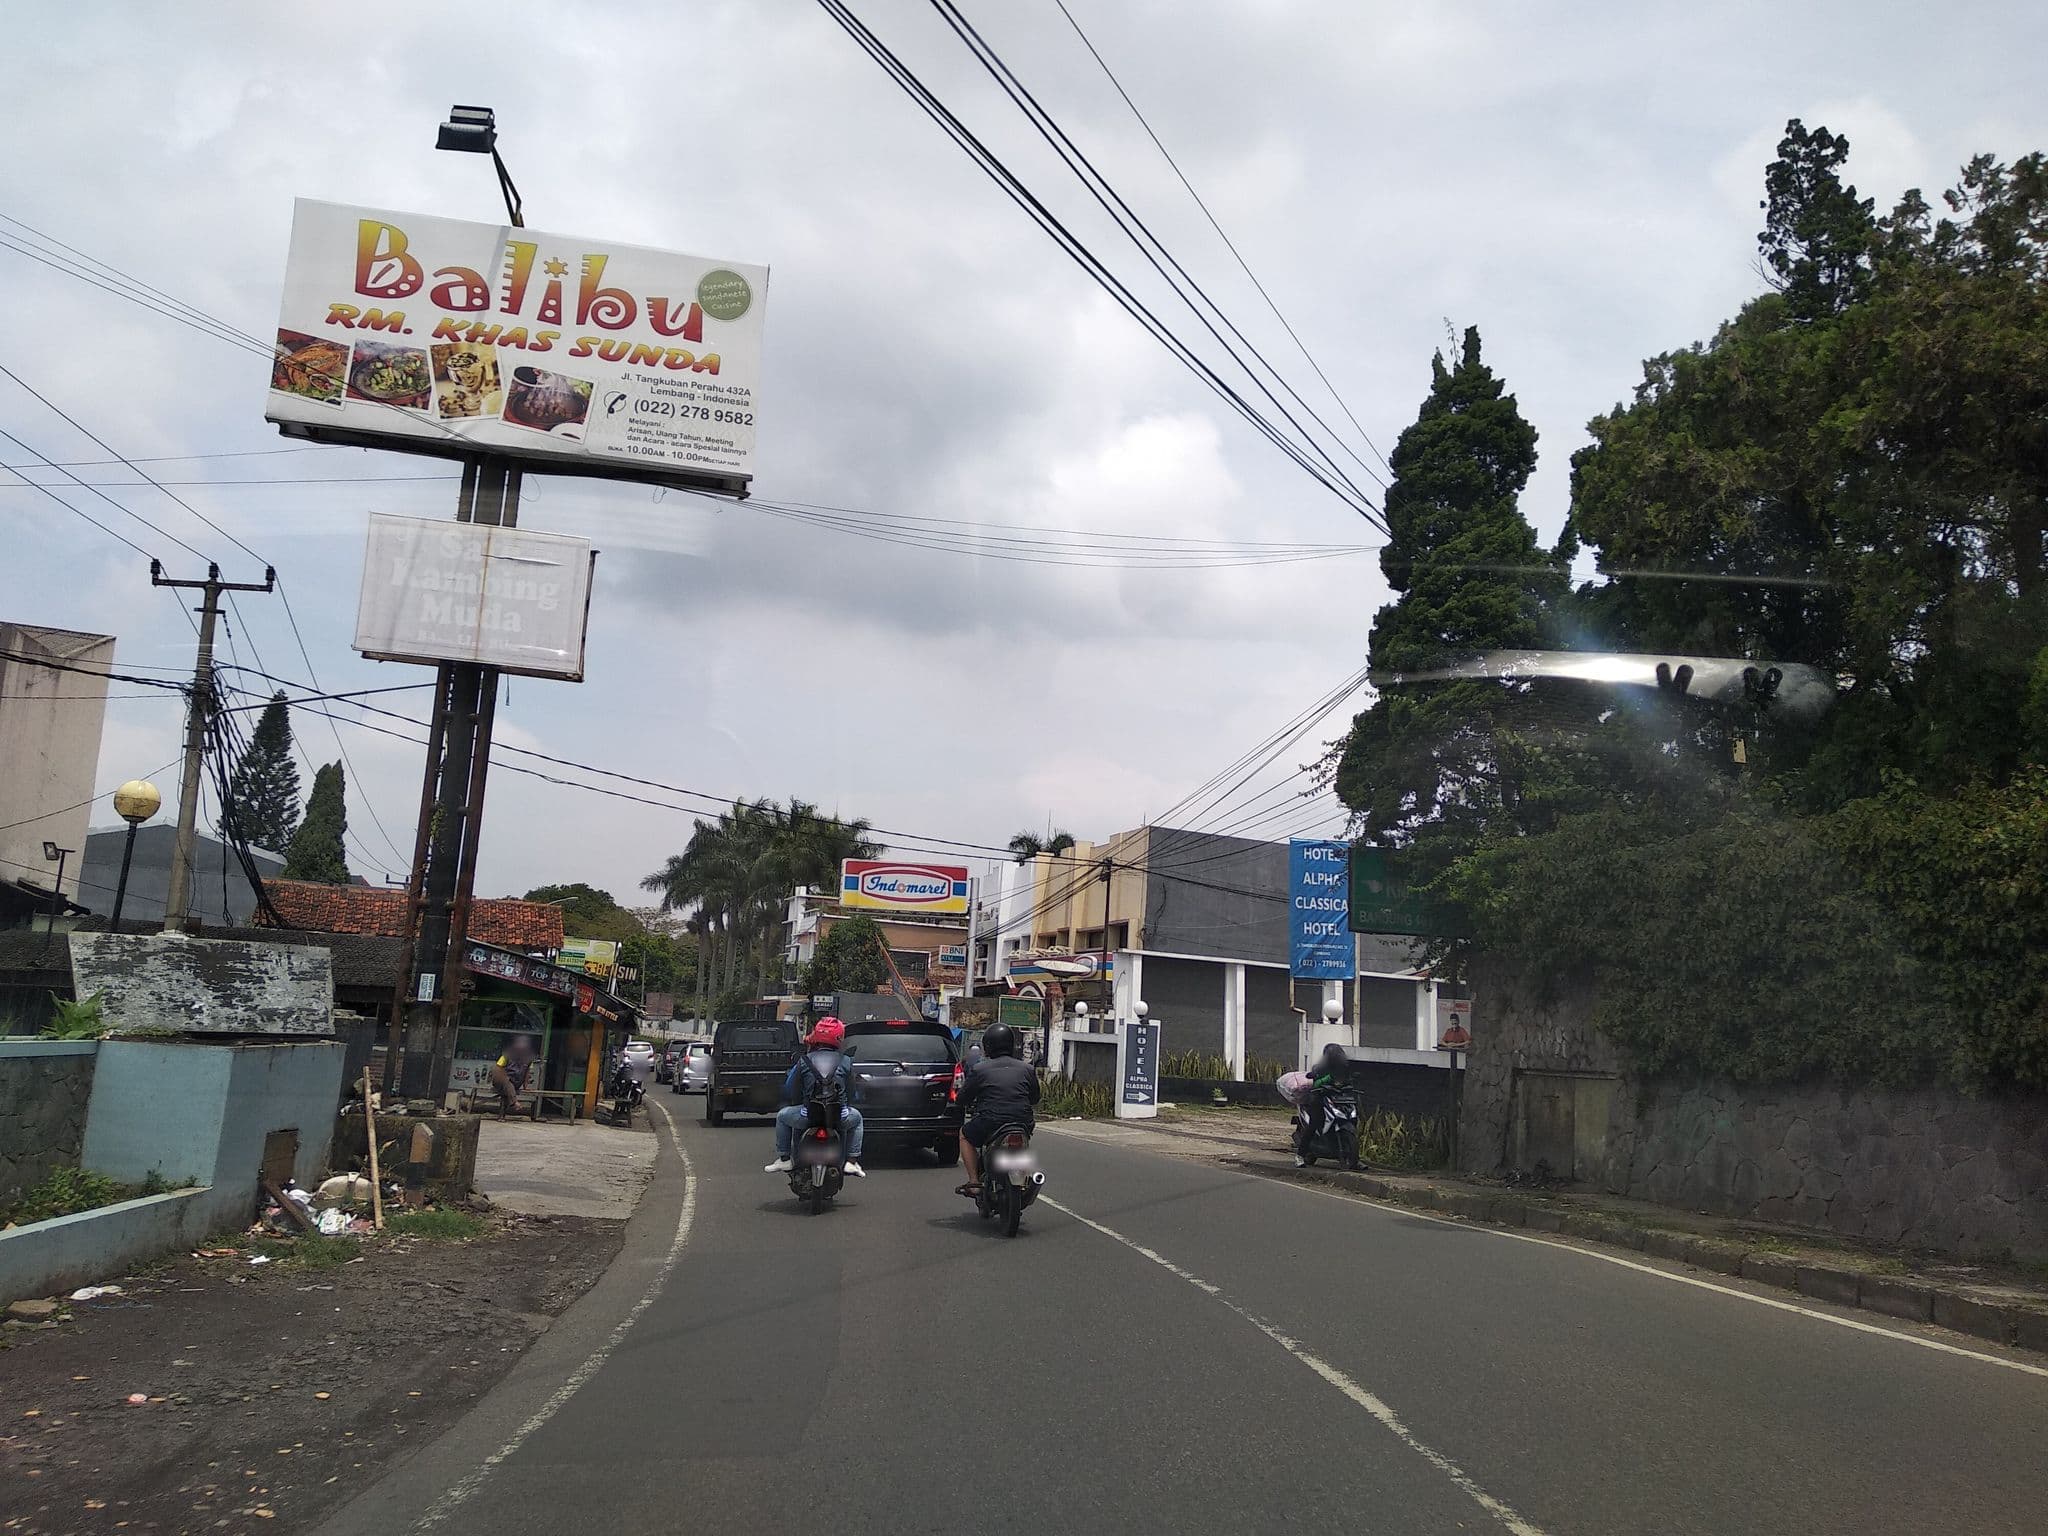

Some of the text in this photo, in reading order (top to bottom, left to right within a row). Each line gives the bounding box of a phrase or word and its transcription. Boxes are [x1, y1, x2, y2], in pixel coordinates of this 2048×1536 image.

[355, 219, 703, 343] Balibu
[325, 303, 721, 376] RM. KHAS SUNDA
[620, 372, 751, 396] Jl. Tangkuban Perahu 432A
[650, 386, 695, 401] Lembang
[703, 393, 750, 407] Indonesia
[634, 399, 754, 426] (022) 278 9582
[627, 434, 641, 442] dan
[642, 436, 665, 445] Acara
[671, 441, 692, 449] acara
[693, 443, 720, 453] Spesial
[721, 445, 747, 456] lainnya
[628, 426, 654, 437] Arisan,
[656, 430, 678, 440] Ulang
[705, 436, 734, 447] Meeting
[627, 445, 665, 458] 10.00AM
[866, 876, 947, 895] Indomaret
[1295, 896, 1349, 912] CLASSICA
[1303, 921, 1341, 936] HOTEL
[469, 953, 487, 963] TOP
[530, 970, 549, 980] TOP
[596, 962, 638, 981] BENSIN
[1136, 1027, 1147, 1075] HOTEL
